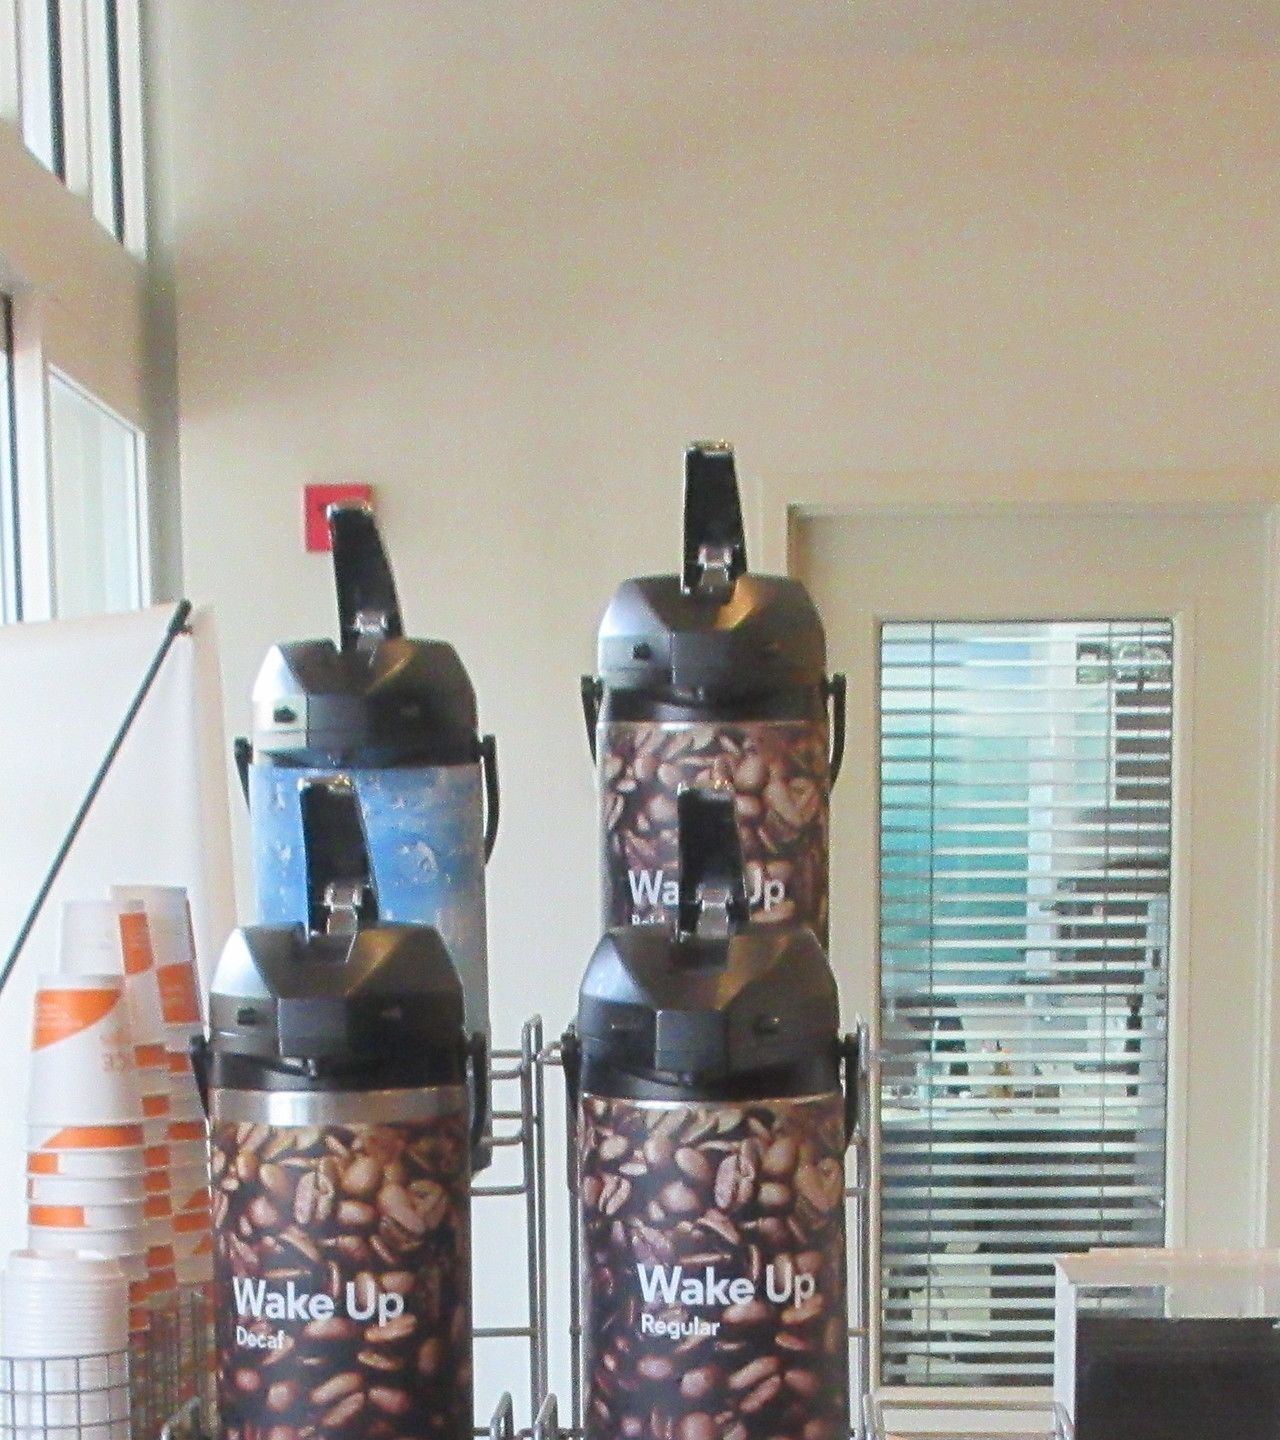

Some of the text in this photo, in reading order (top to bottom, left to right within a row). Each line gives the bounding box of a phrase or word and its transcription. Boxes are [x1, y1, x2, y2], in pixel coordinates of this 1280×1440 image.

[628, 868, 680, 906] Wa
[232, 1276, 405, 1328] Wake Up
[636, 1262, 815, 1309] Wake Up
[235, 1325, 286, 1349] Decaf
[640, 1313, 720, 1340] Regular
